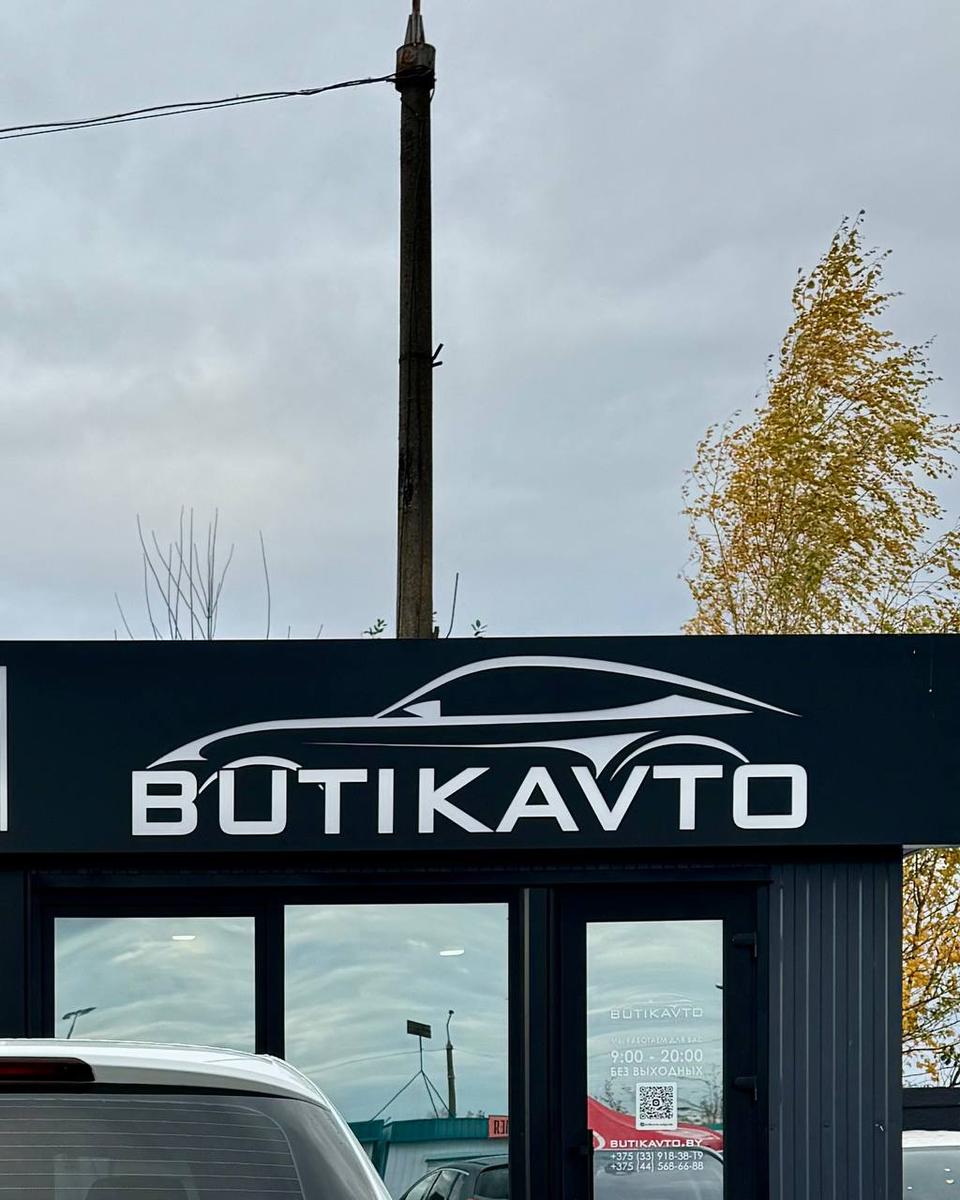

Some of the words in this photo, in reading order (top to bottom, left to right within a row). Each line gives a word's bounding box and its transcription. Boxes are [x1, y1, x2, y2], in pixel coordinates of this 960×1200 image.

[131, 763, 808, 836] BUTIKAVTO
[610, 1007, 703, 1019] BUTIKAVTO
[611, 1050, 643, 1064] 9:00
[660, 1049, 703, 1063] 20:00
[610, 1067, 629, 1077] БЕЗ
[633, 1066, 703, 1077] ВЫХОДНЫХ
[610, 1139, 703, 1148] BUTIKAVTO.BY
[611, 1152, 633, 1161] +375
[637, 1152, 654, 1161] (33)
[657, 1152, 704, 1161] 918-38-19
[611, 1163, 633, 1171] +375
[637, 1162, 654, 1172] (44)
[657, 1162, 704, 1171] 568-66-88
